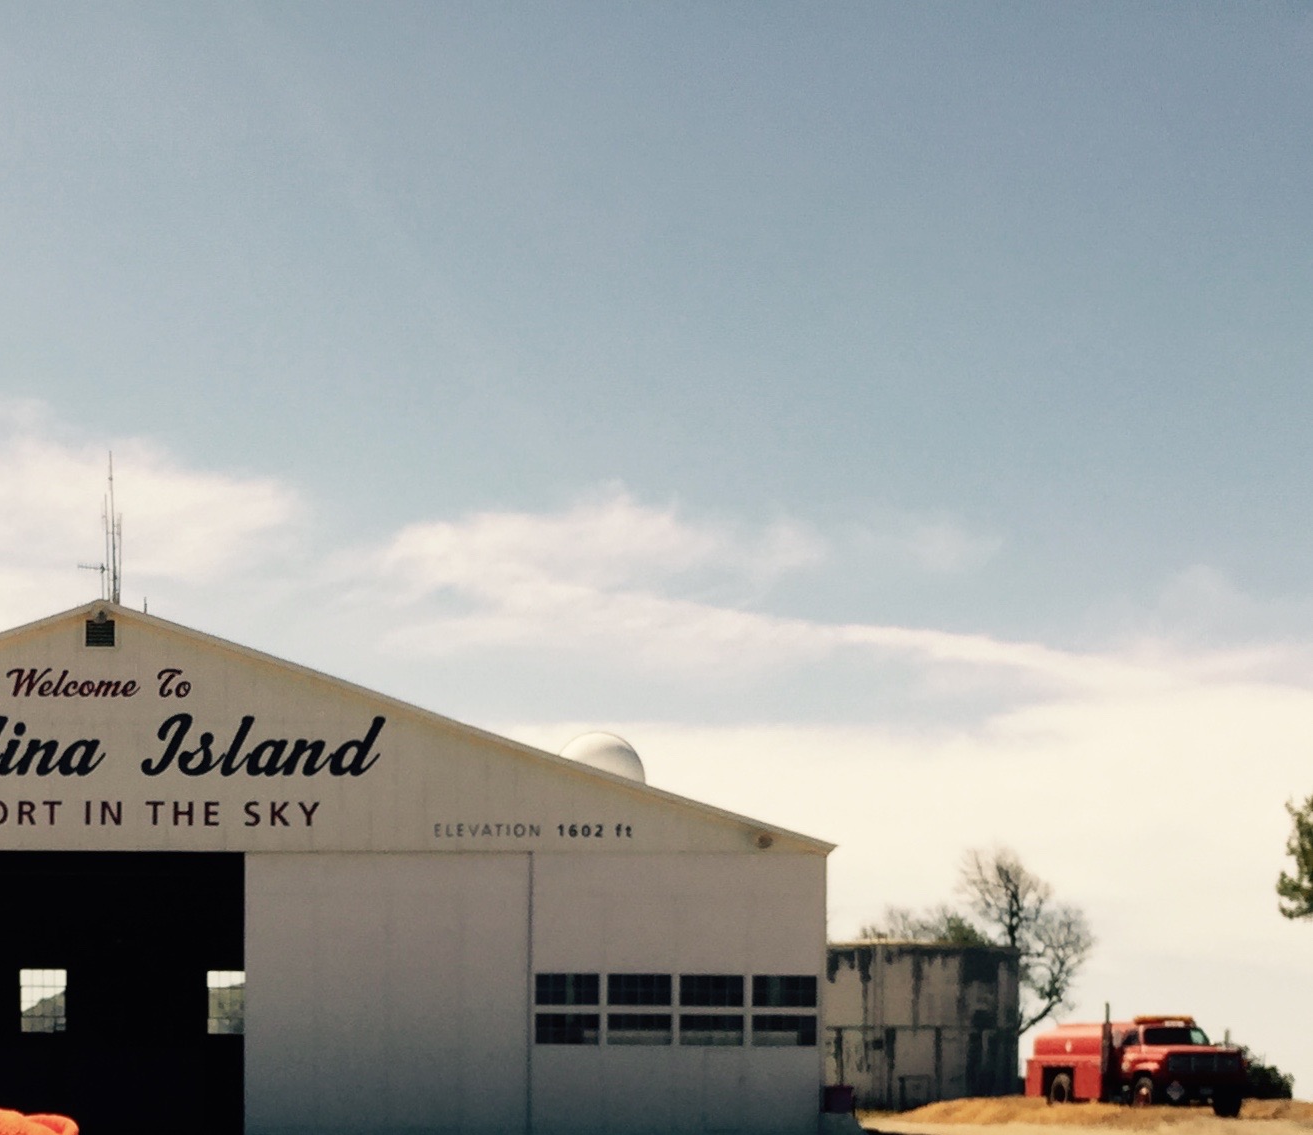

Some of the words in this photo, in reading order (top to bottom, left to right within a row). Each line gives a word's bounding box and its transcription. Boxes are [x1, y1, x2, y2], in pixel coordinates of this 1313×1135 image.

[6, 667, 141, 698] Welcome
[157, 668, 192, 699] To
[140, 712, 386, 777] Island
[85, 800, 123, 827] IN
[145, 800, 220, 827] THE
[244, 800, 321, 828] SKY
[433, 823, 542, 838] ELEVATION
[557, 824, 604, 839] 1602
[614, 823, 633, 839] ft
